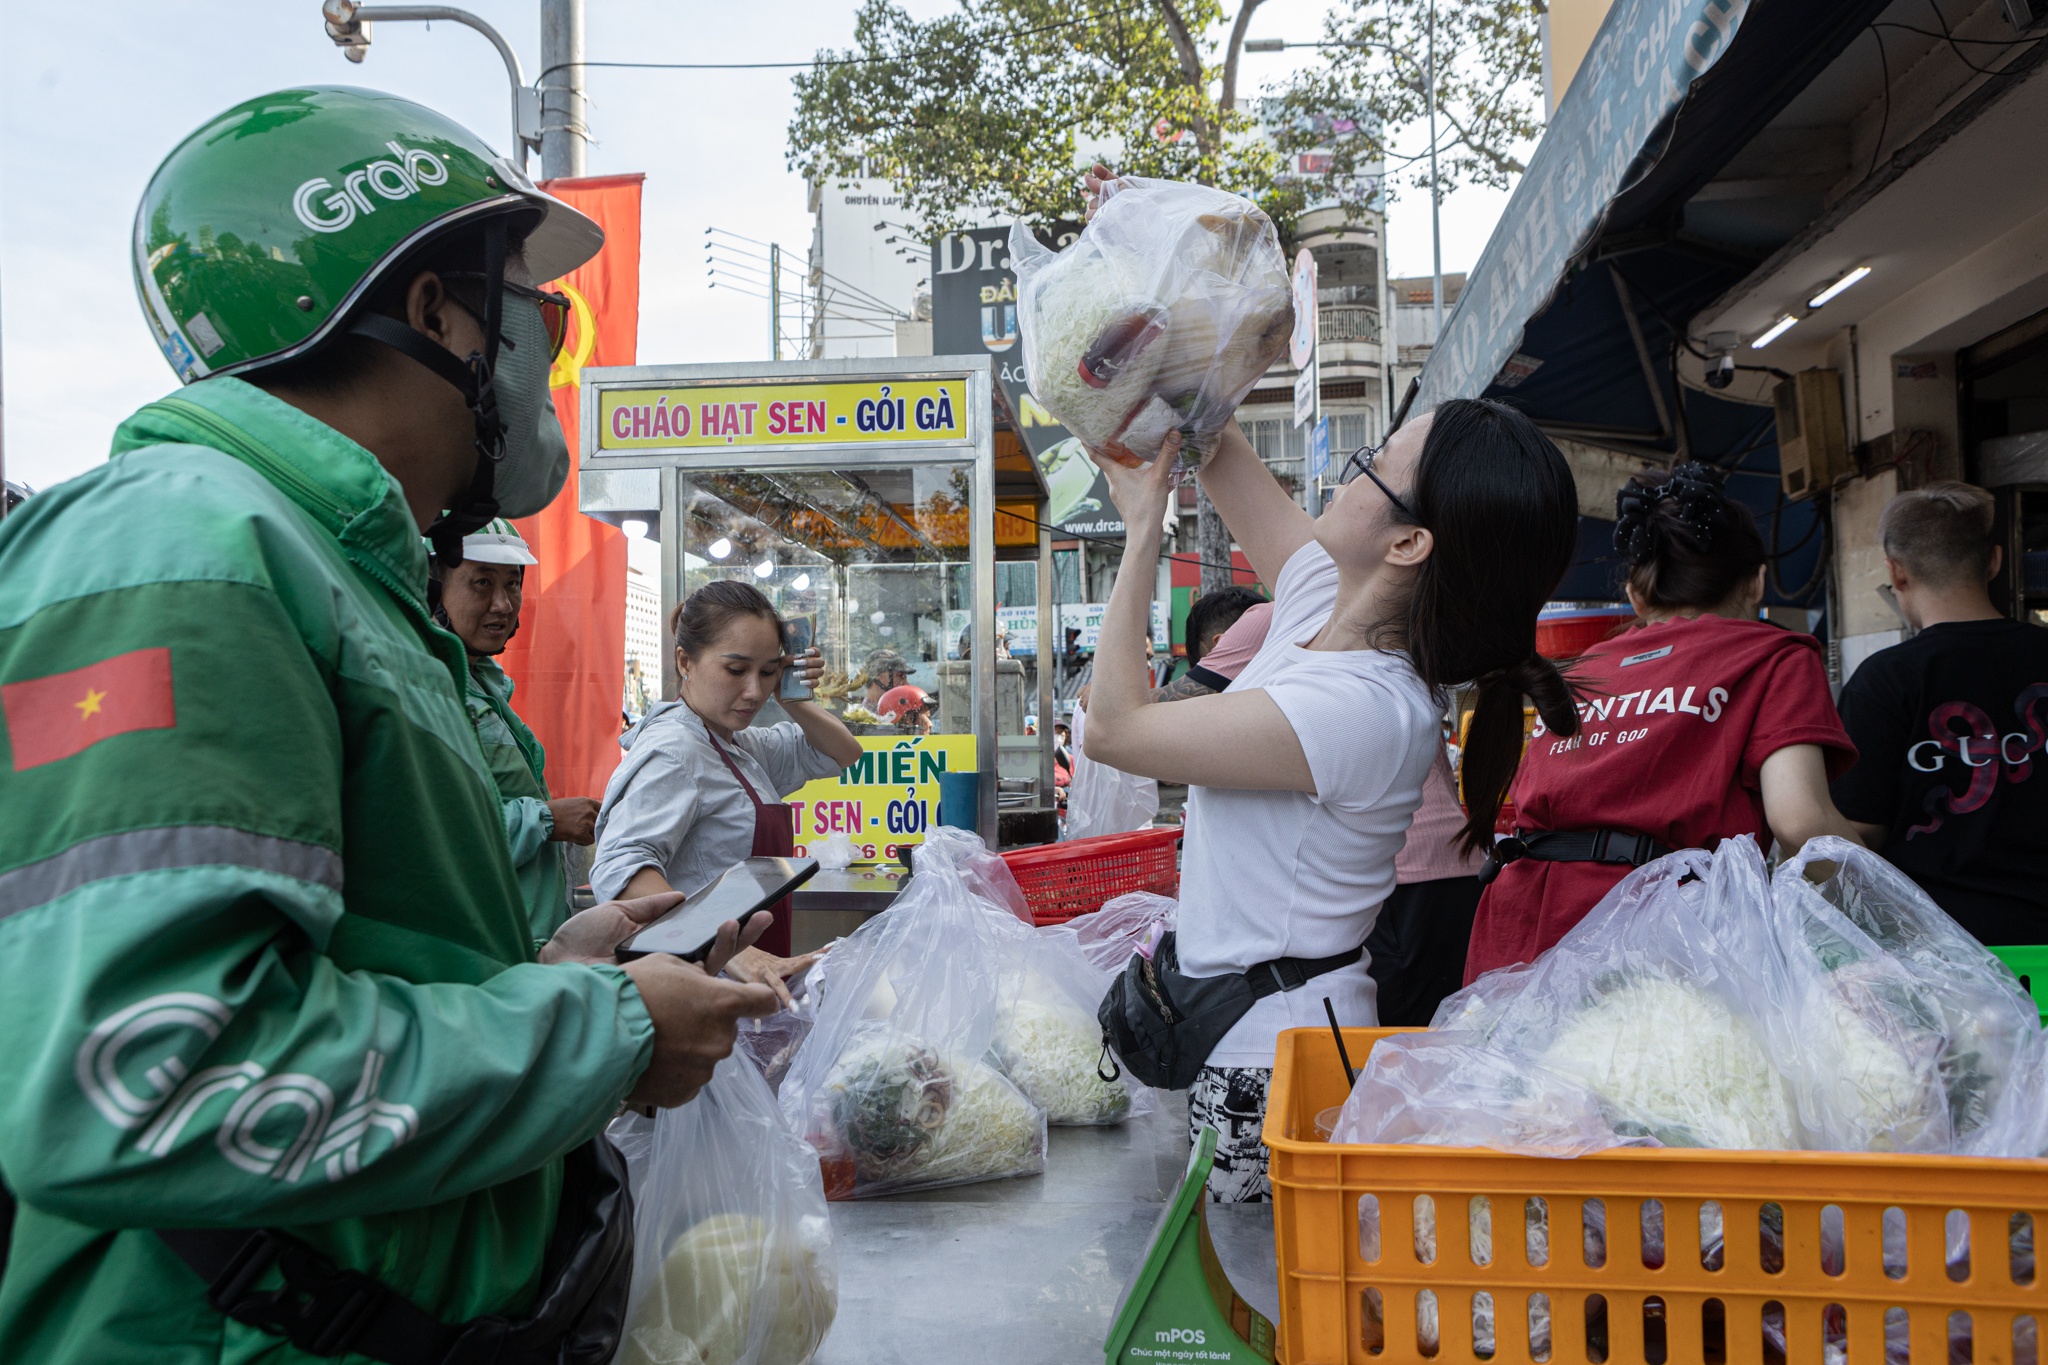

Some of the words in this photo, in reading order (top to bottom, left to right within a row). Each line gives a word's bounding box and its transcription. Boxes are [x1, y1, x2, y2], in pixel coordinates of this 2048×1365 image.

[292, 140, 449, 234] Grab
[611, 396, 692, 440] CHÁO
[700, 402, 758, 444] HẠT
[767, 400, 827, 436] SEN
[855, 385, 906, 434] GỎI
[914, 387, 956, 432] GÀ
[1589, 731, 1609, 746] OF
[1617, 727, 1649, 744] GOD
[1907, 733, 2048, 772] GUC
[841, 737, 947, 786] MIẾN
[813, 801, 862, 835] SEN
[886, 786, 927, 834] GỎI
[1130, 1347, 1153, 1357] Chúc
[1154, 1348, 1171, 1360] một
[1172, 1350, 1194, 1361] ngày
[1195, 1349, 1208, 1360] tốt
[1155, 1328, 1206, 1344] mPOS
